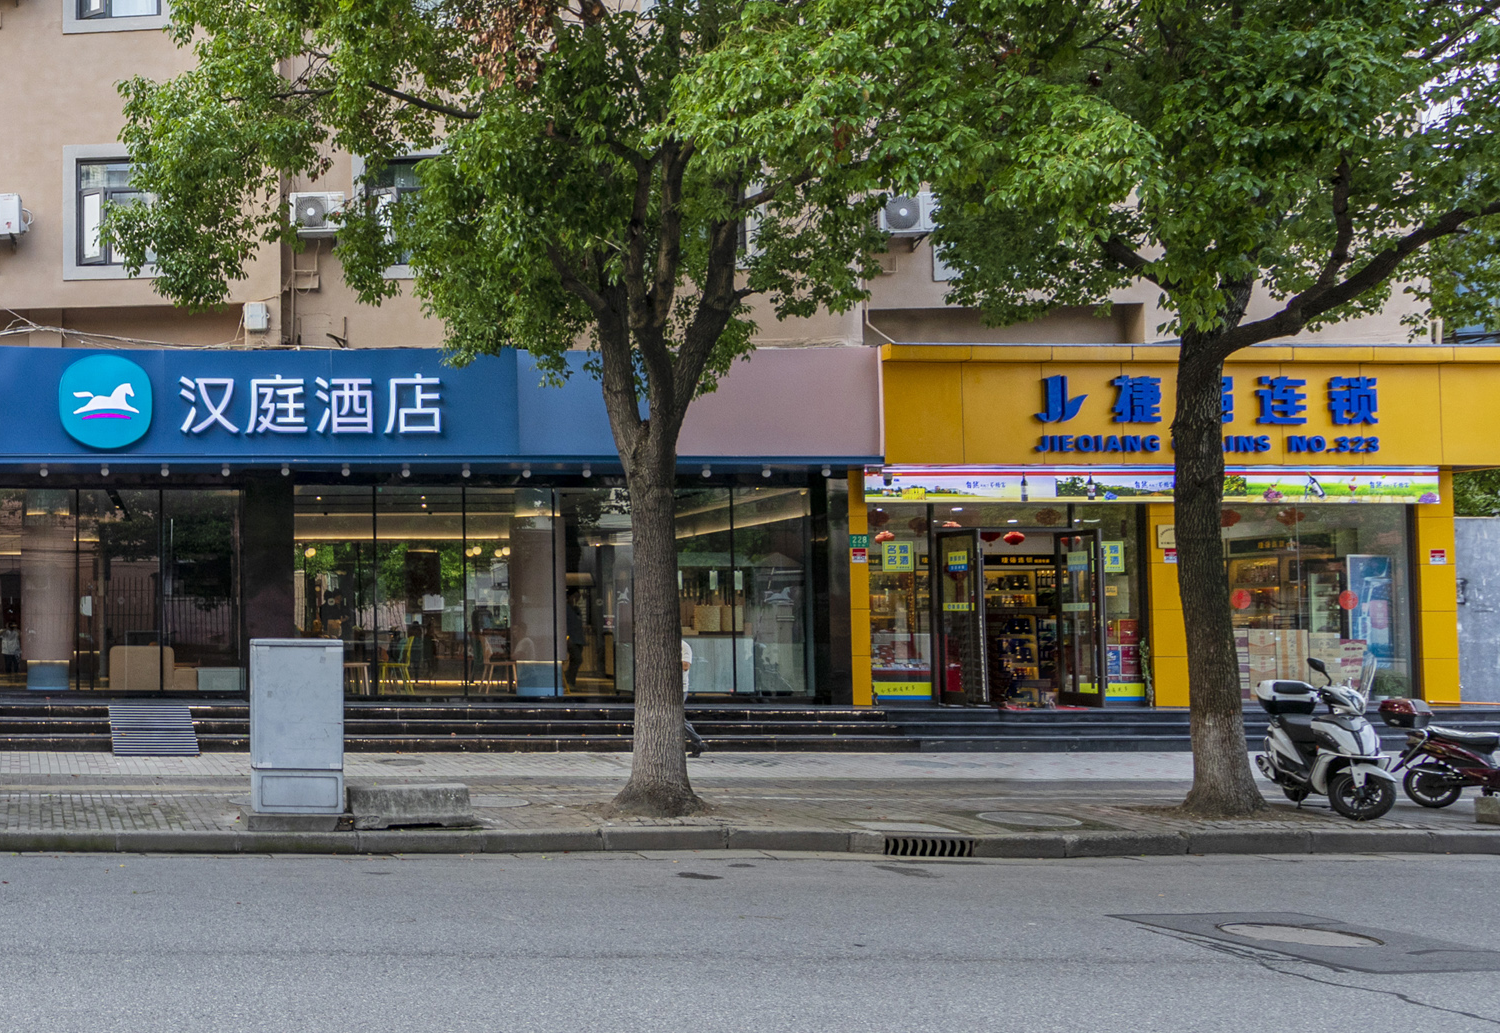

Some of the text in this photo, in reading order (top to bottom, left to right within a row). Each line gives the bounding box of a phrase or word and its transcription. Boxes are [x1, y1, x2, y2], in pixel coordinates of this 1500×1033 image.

[177, 373, 442, 434] 汉庭酒店
[1110, 374, 1380, 425] 捷连锁
[1034, 434, 1380, 454] JIEQIANG INS NO.323
[852, 535, 868, 544] 228
